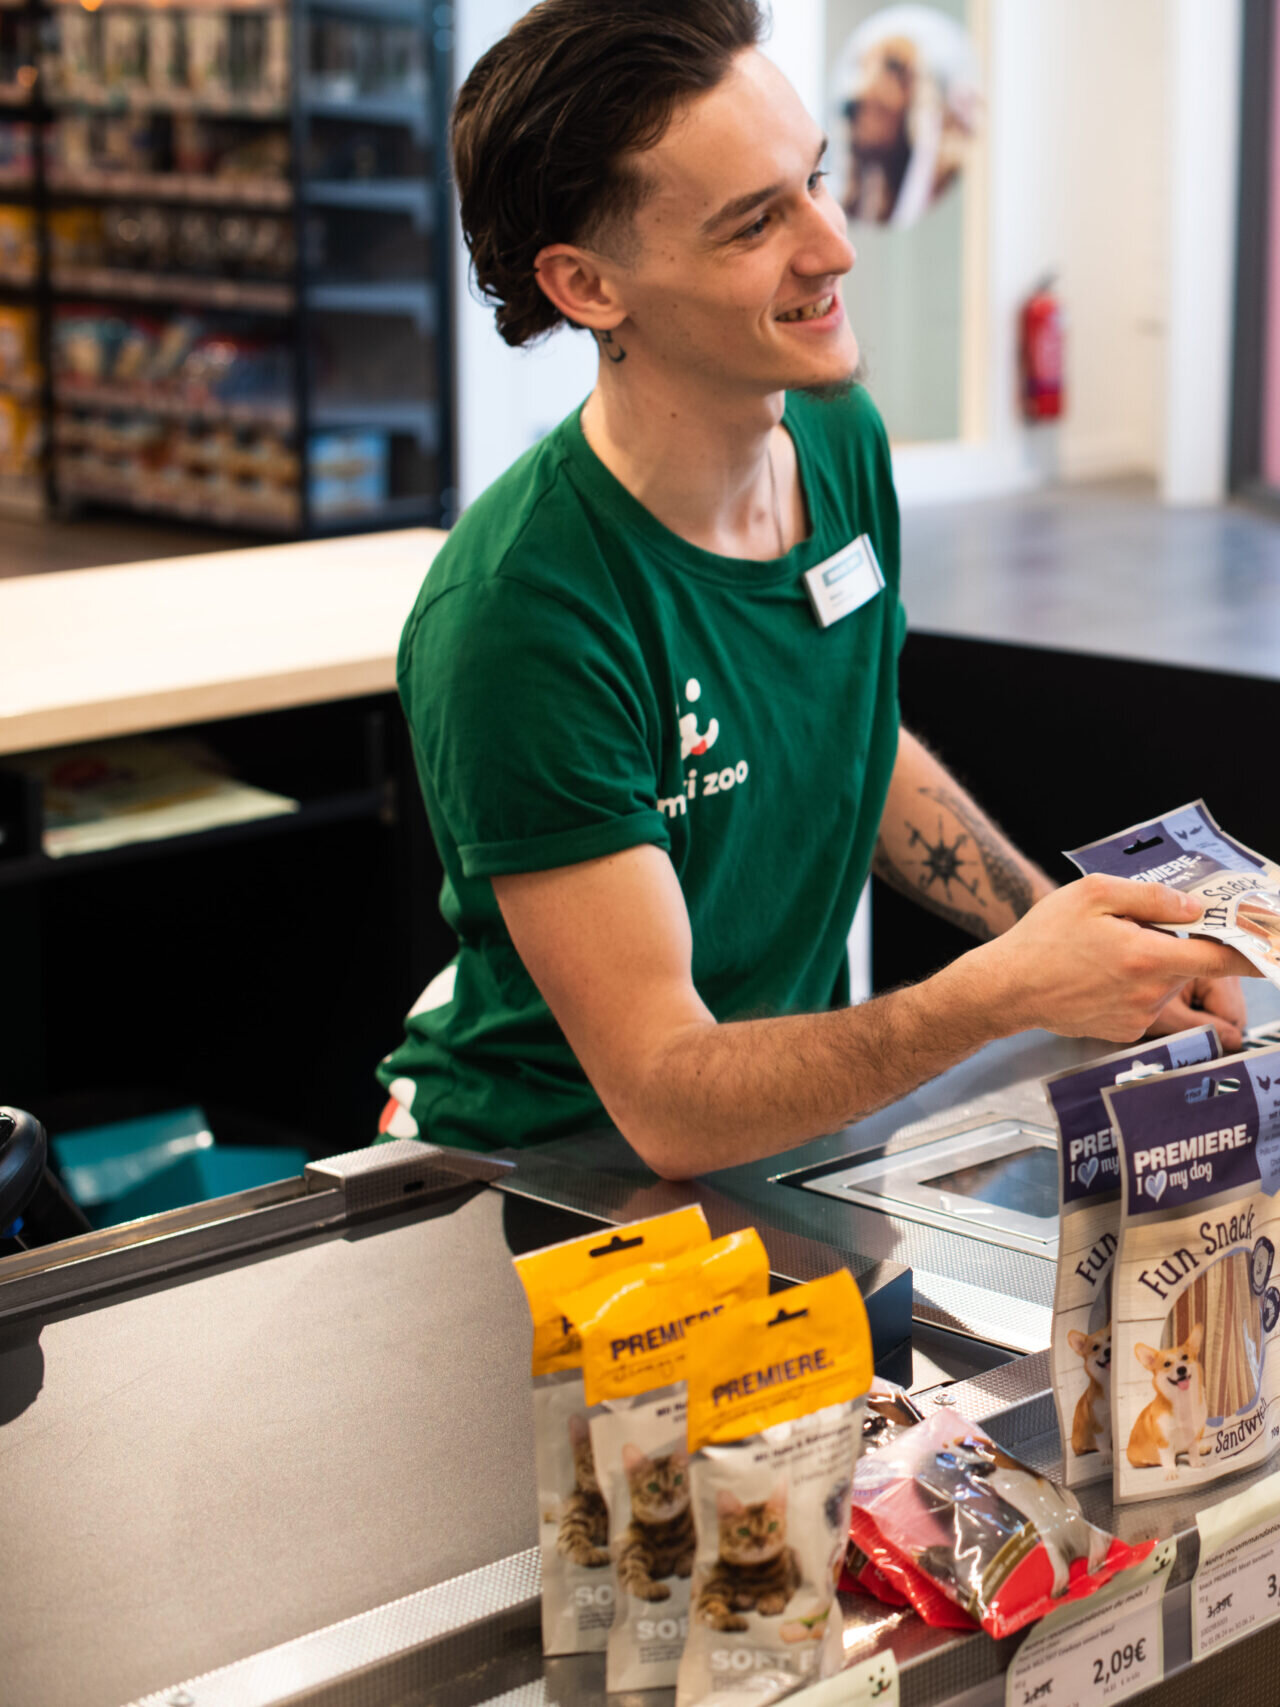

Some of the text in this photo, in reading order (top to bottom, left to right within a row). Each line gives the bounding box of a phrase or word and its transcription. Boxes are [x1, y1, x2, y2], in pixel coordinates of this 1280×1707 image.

[703, 760, 749, 796] zoo
[1203, 877, 1265, 901] Snack
[1070, 1155, 1119, 1183] I my
[1133, 1123, 1253, 1175] PREMIERE.
[1136, 1161, 1213, 1196] I my dog
[1138, 1247, 1200, 1301] Fun
[1200, 1203, 1255, 1256] Snack
[1215, 1397, 1267, 1454] Sandwich
[1093, 1637, 1147, 1685] 2,09€
